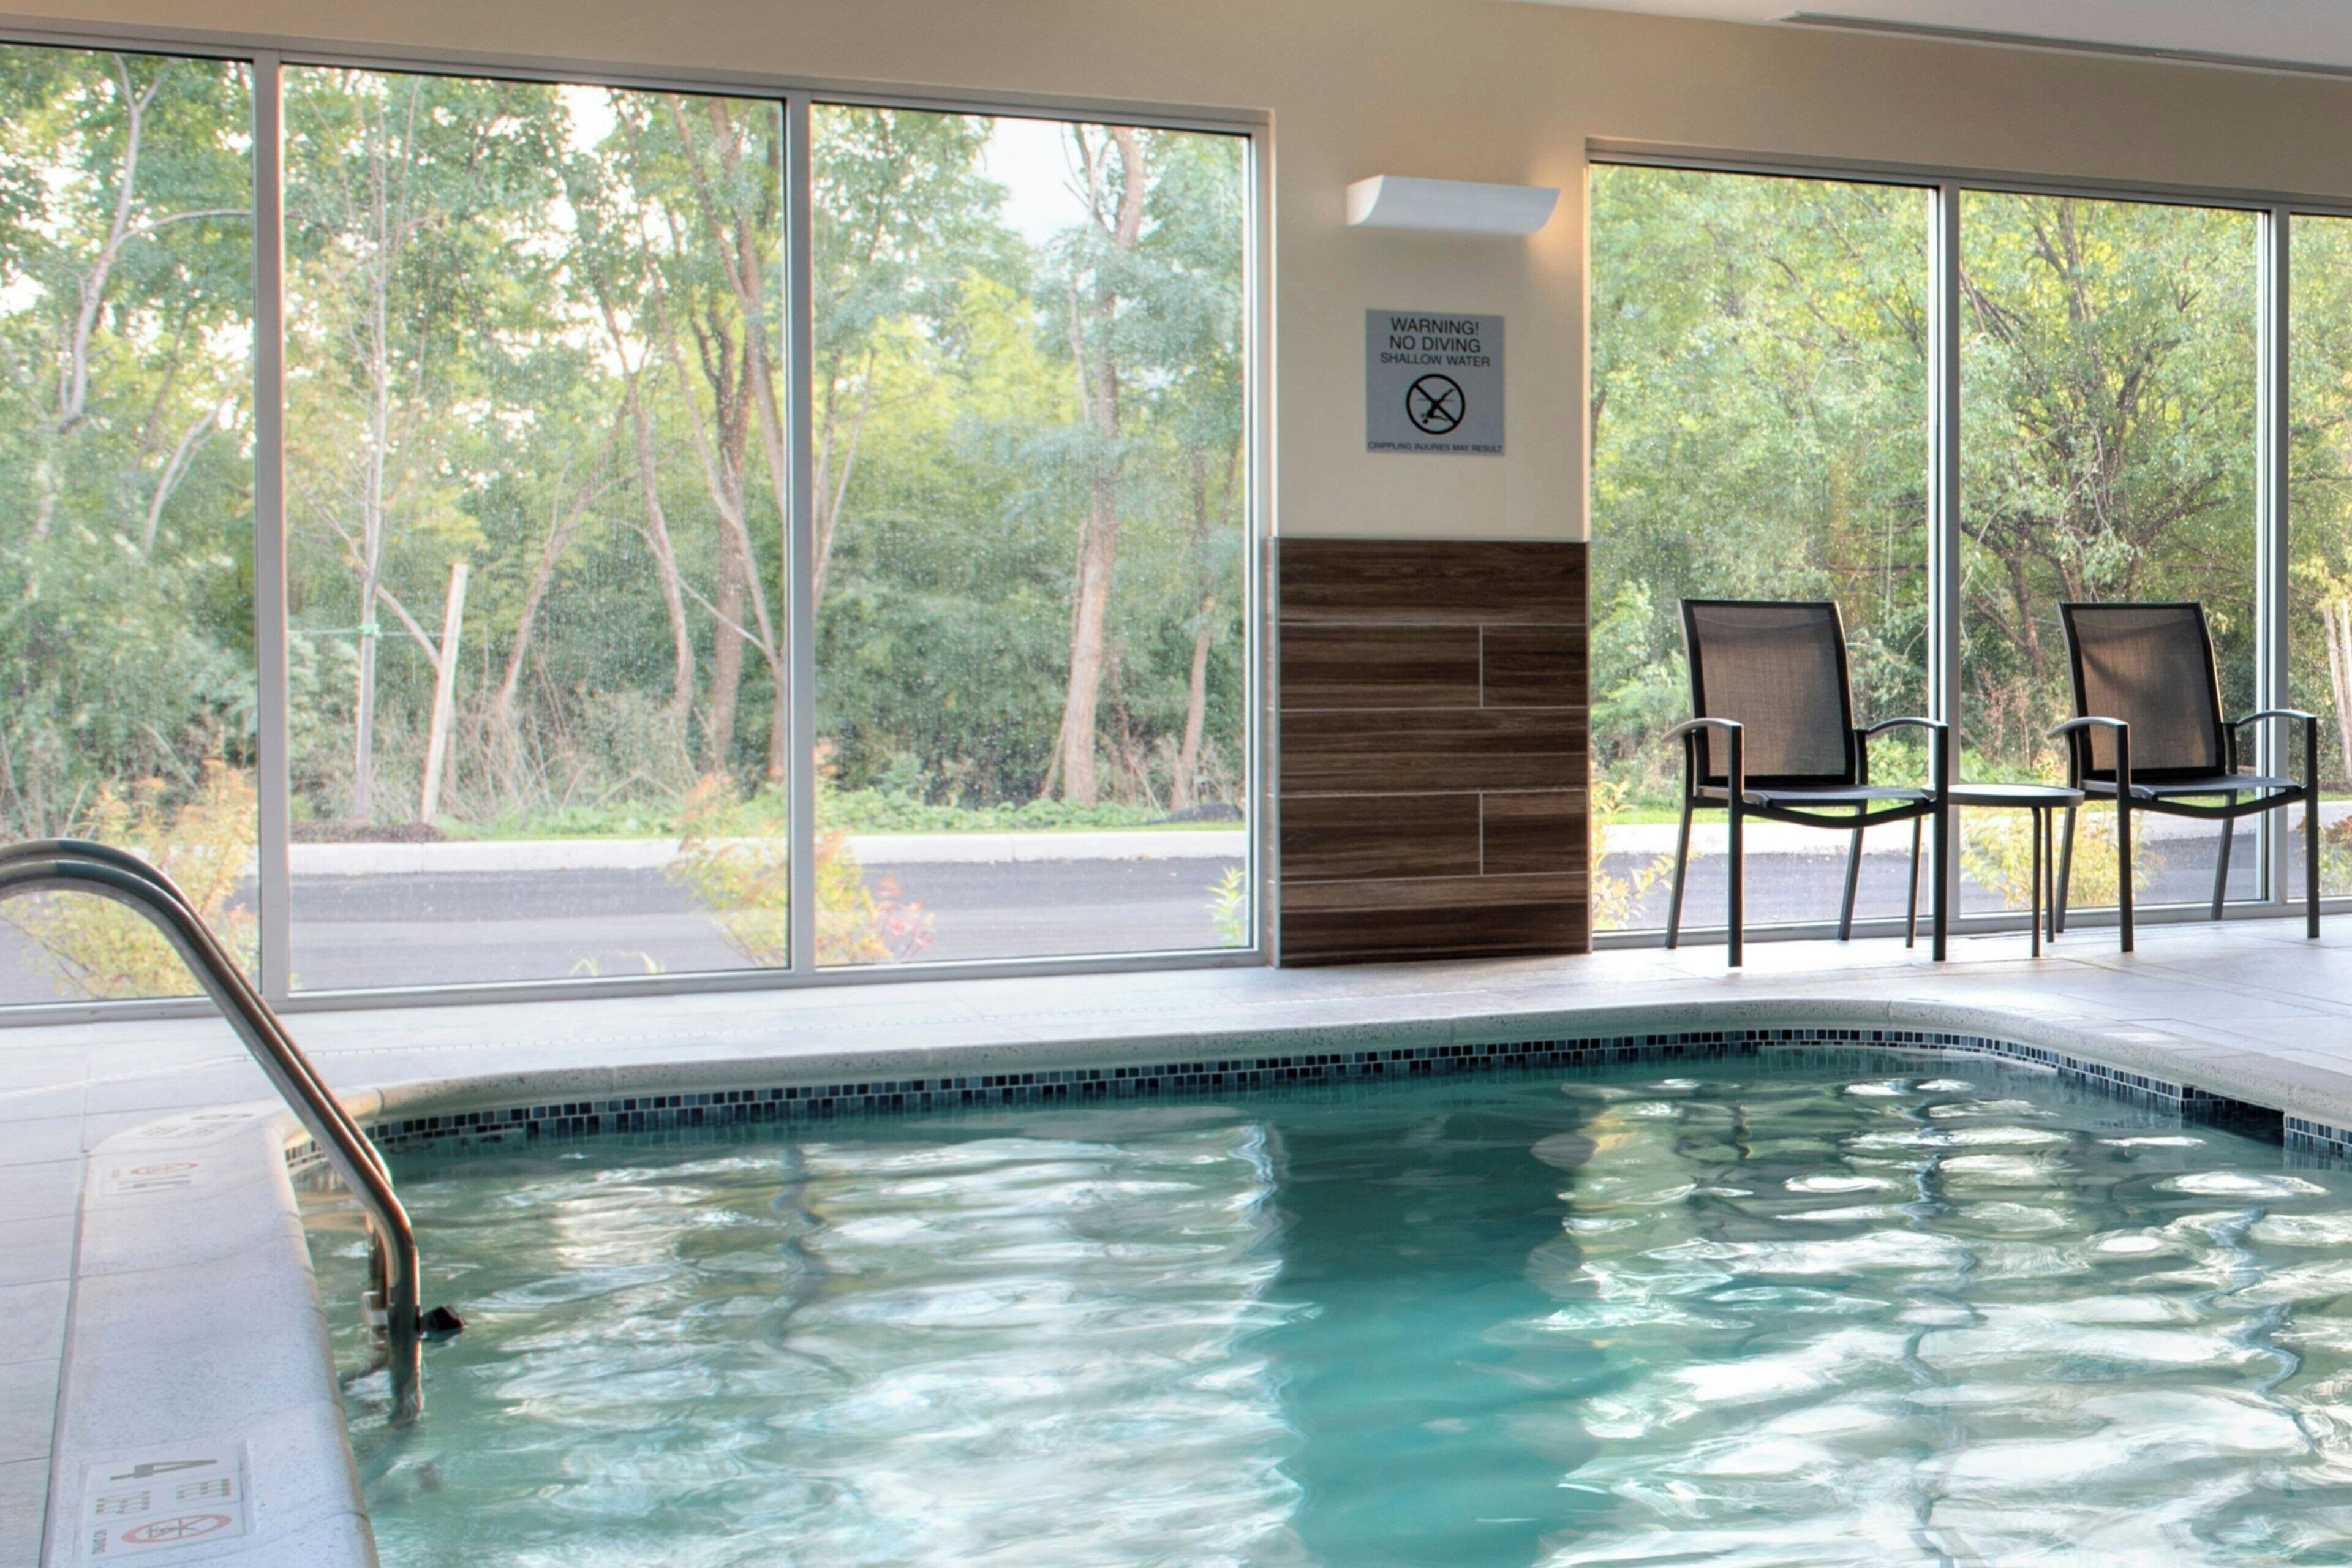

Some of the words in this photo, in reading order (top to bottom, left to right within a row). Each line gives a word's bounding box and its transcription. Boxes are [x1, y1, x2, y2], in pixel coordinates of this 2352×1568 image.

[1391, 318, 1479, 335] WARNING!
[1389, 336, 1415, 350] NO
[1422, 337, 1480, 352] DIVING
[1380, 352, 1442, 364] SHALLOW
[1447, 356, 1490, 367] WATER
[110, 1459, 217, 1480] 4
